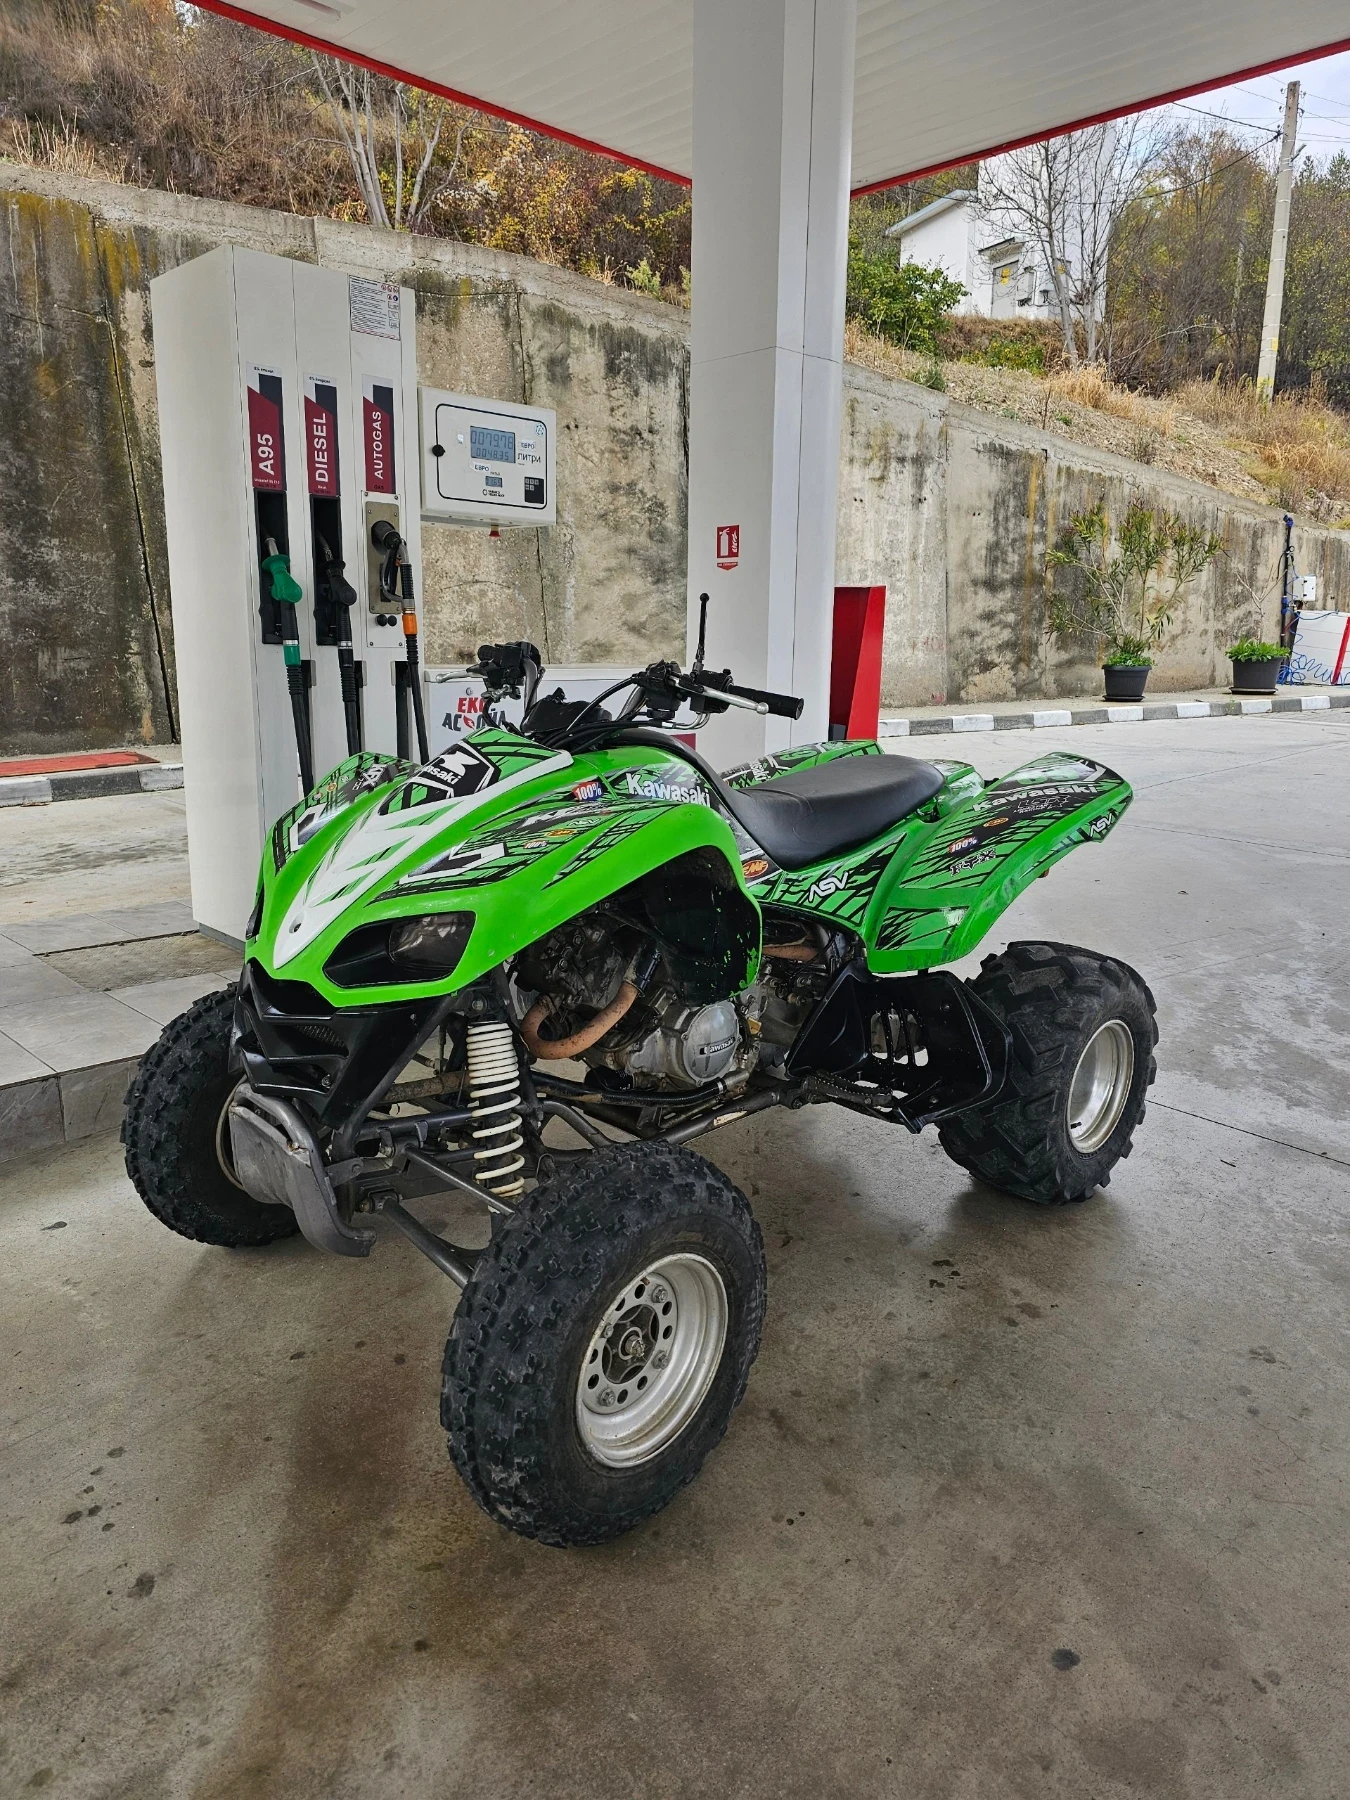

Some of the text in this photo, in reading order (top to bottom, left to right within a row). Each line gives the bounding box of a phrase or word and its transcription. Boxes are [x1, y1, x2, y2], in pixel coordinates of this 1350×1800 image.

[257, 433, 275, 476] A95
[313, 412, 329, 483] DIESEL
[372, 411, 384, 480] AUTOGAS
[575, 782, 602, 801] 100%
[625, 772, 711, 809] Kawasaki
[972, 784, 1098, 812] Kawasaki
[1090, 812, 1113, 838] ASV
[950, 836, 978, 854] 100%
[808, 870, 849, 903] ASV
